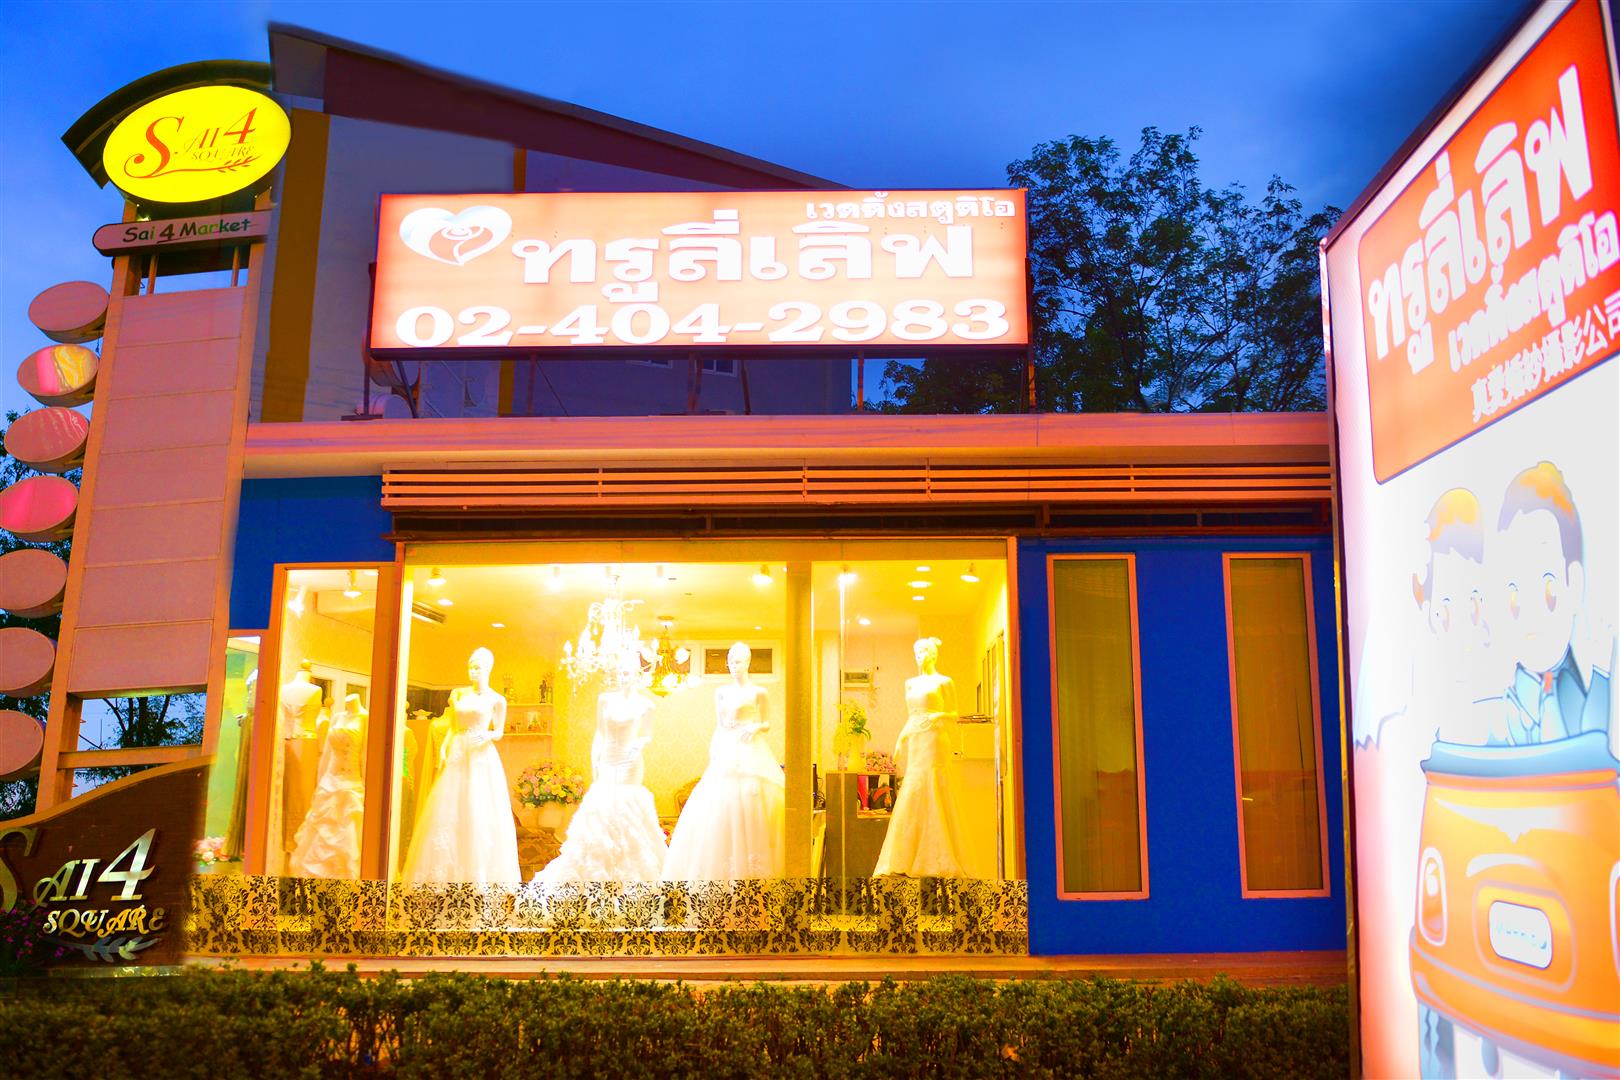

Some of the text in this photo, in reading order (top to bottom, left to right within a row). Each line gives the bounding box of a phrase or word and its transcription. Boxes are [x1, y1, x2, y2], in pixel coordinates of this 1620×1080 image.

[223, 107, 258, 145] 4
[122, 218, 251, 243] Sai 4 Market
[1368, 64, 1593, 375] ทรูลี่เลิฟ
[511, 208, 973, 302] ทรูลี่เลิฟ
[395, 299, 1009, 347] 02-404-2983
[97, 827, 156, 902] 4
[42, 904, 165, 938] SQUARE
